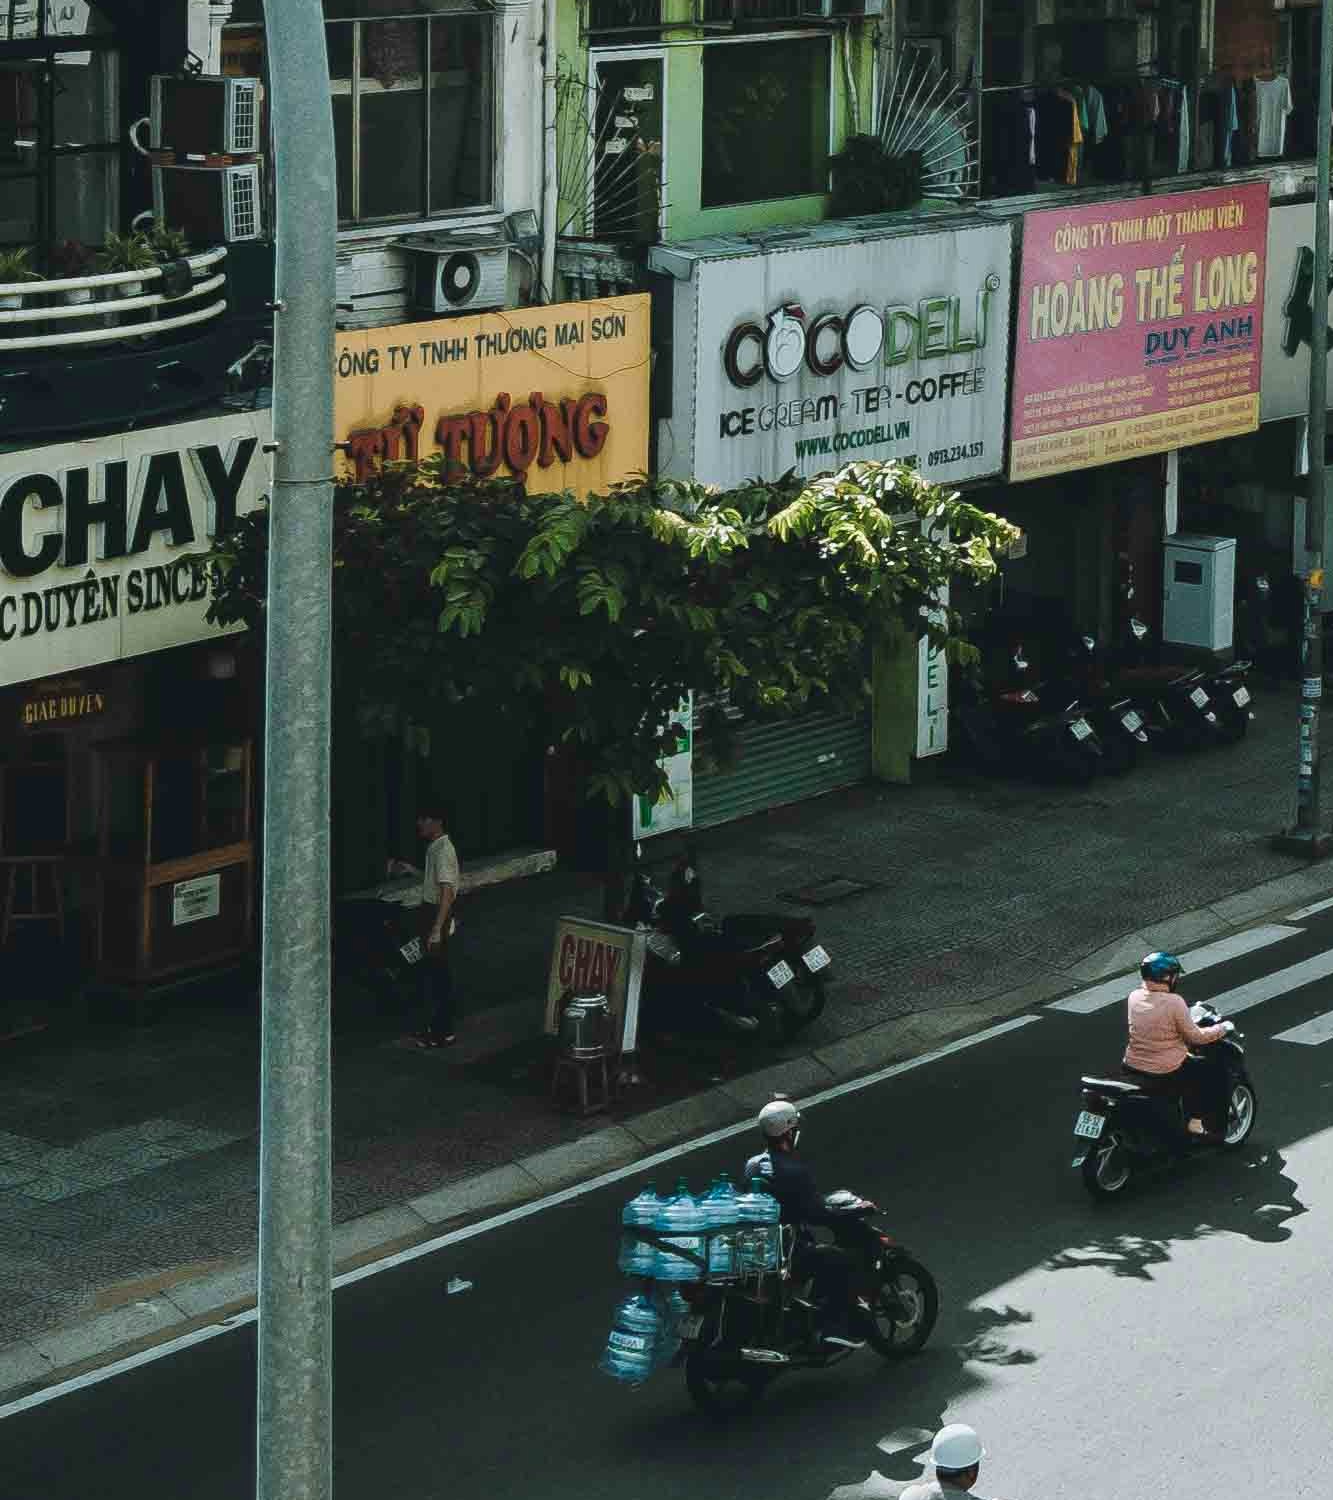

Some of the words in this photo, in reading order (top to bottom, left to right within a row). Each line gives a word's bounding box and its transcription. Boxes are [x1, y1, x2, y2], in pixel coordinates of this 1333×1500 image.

[1055, 222, 1089, 253] CÔNG
[1091, 224, 1107, 249] TY
[1110, 216, 1144, 246] TNHH
[1145, 208, 1172, 243] MỘT
[1176, 204, 1213, 234] THÀNH
[1030, 263, 1124, 342] HOÀNG
[1134, 244, 1186, 323] THẾ
[1191, 251, 1258, 313] LONG
[336, 346, 379, 378] ÔNG
[387, 345, 412, 370] TY
[420, 336, 468, 366] TNHH
[555, 317, 584, 350] MẠI
[592, 313, 626, 341] SƠN
[724, 289, 990, 389] COCODELI
[1144, 325, 1196, 357] DUY
[1203, 311, 1254, 346] ANH
[437, 391, 609, 485] TƯỢNG
[720, 407, 755, 438] ICE
[757, 394, 838, 432] CREAM
[850, 384, 890, 416] TEA
[905, 367, 985, 405] COFFEE
[794, 421, 911, 460] WWW.COCODELI.VN
[927, 441, 985, 467] 0913.234.151
[0, 436, 258, 577] CHAY
[20, 567, 121, 637] DUYÊN
[127, 562, 208, 613] SINCE
